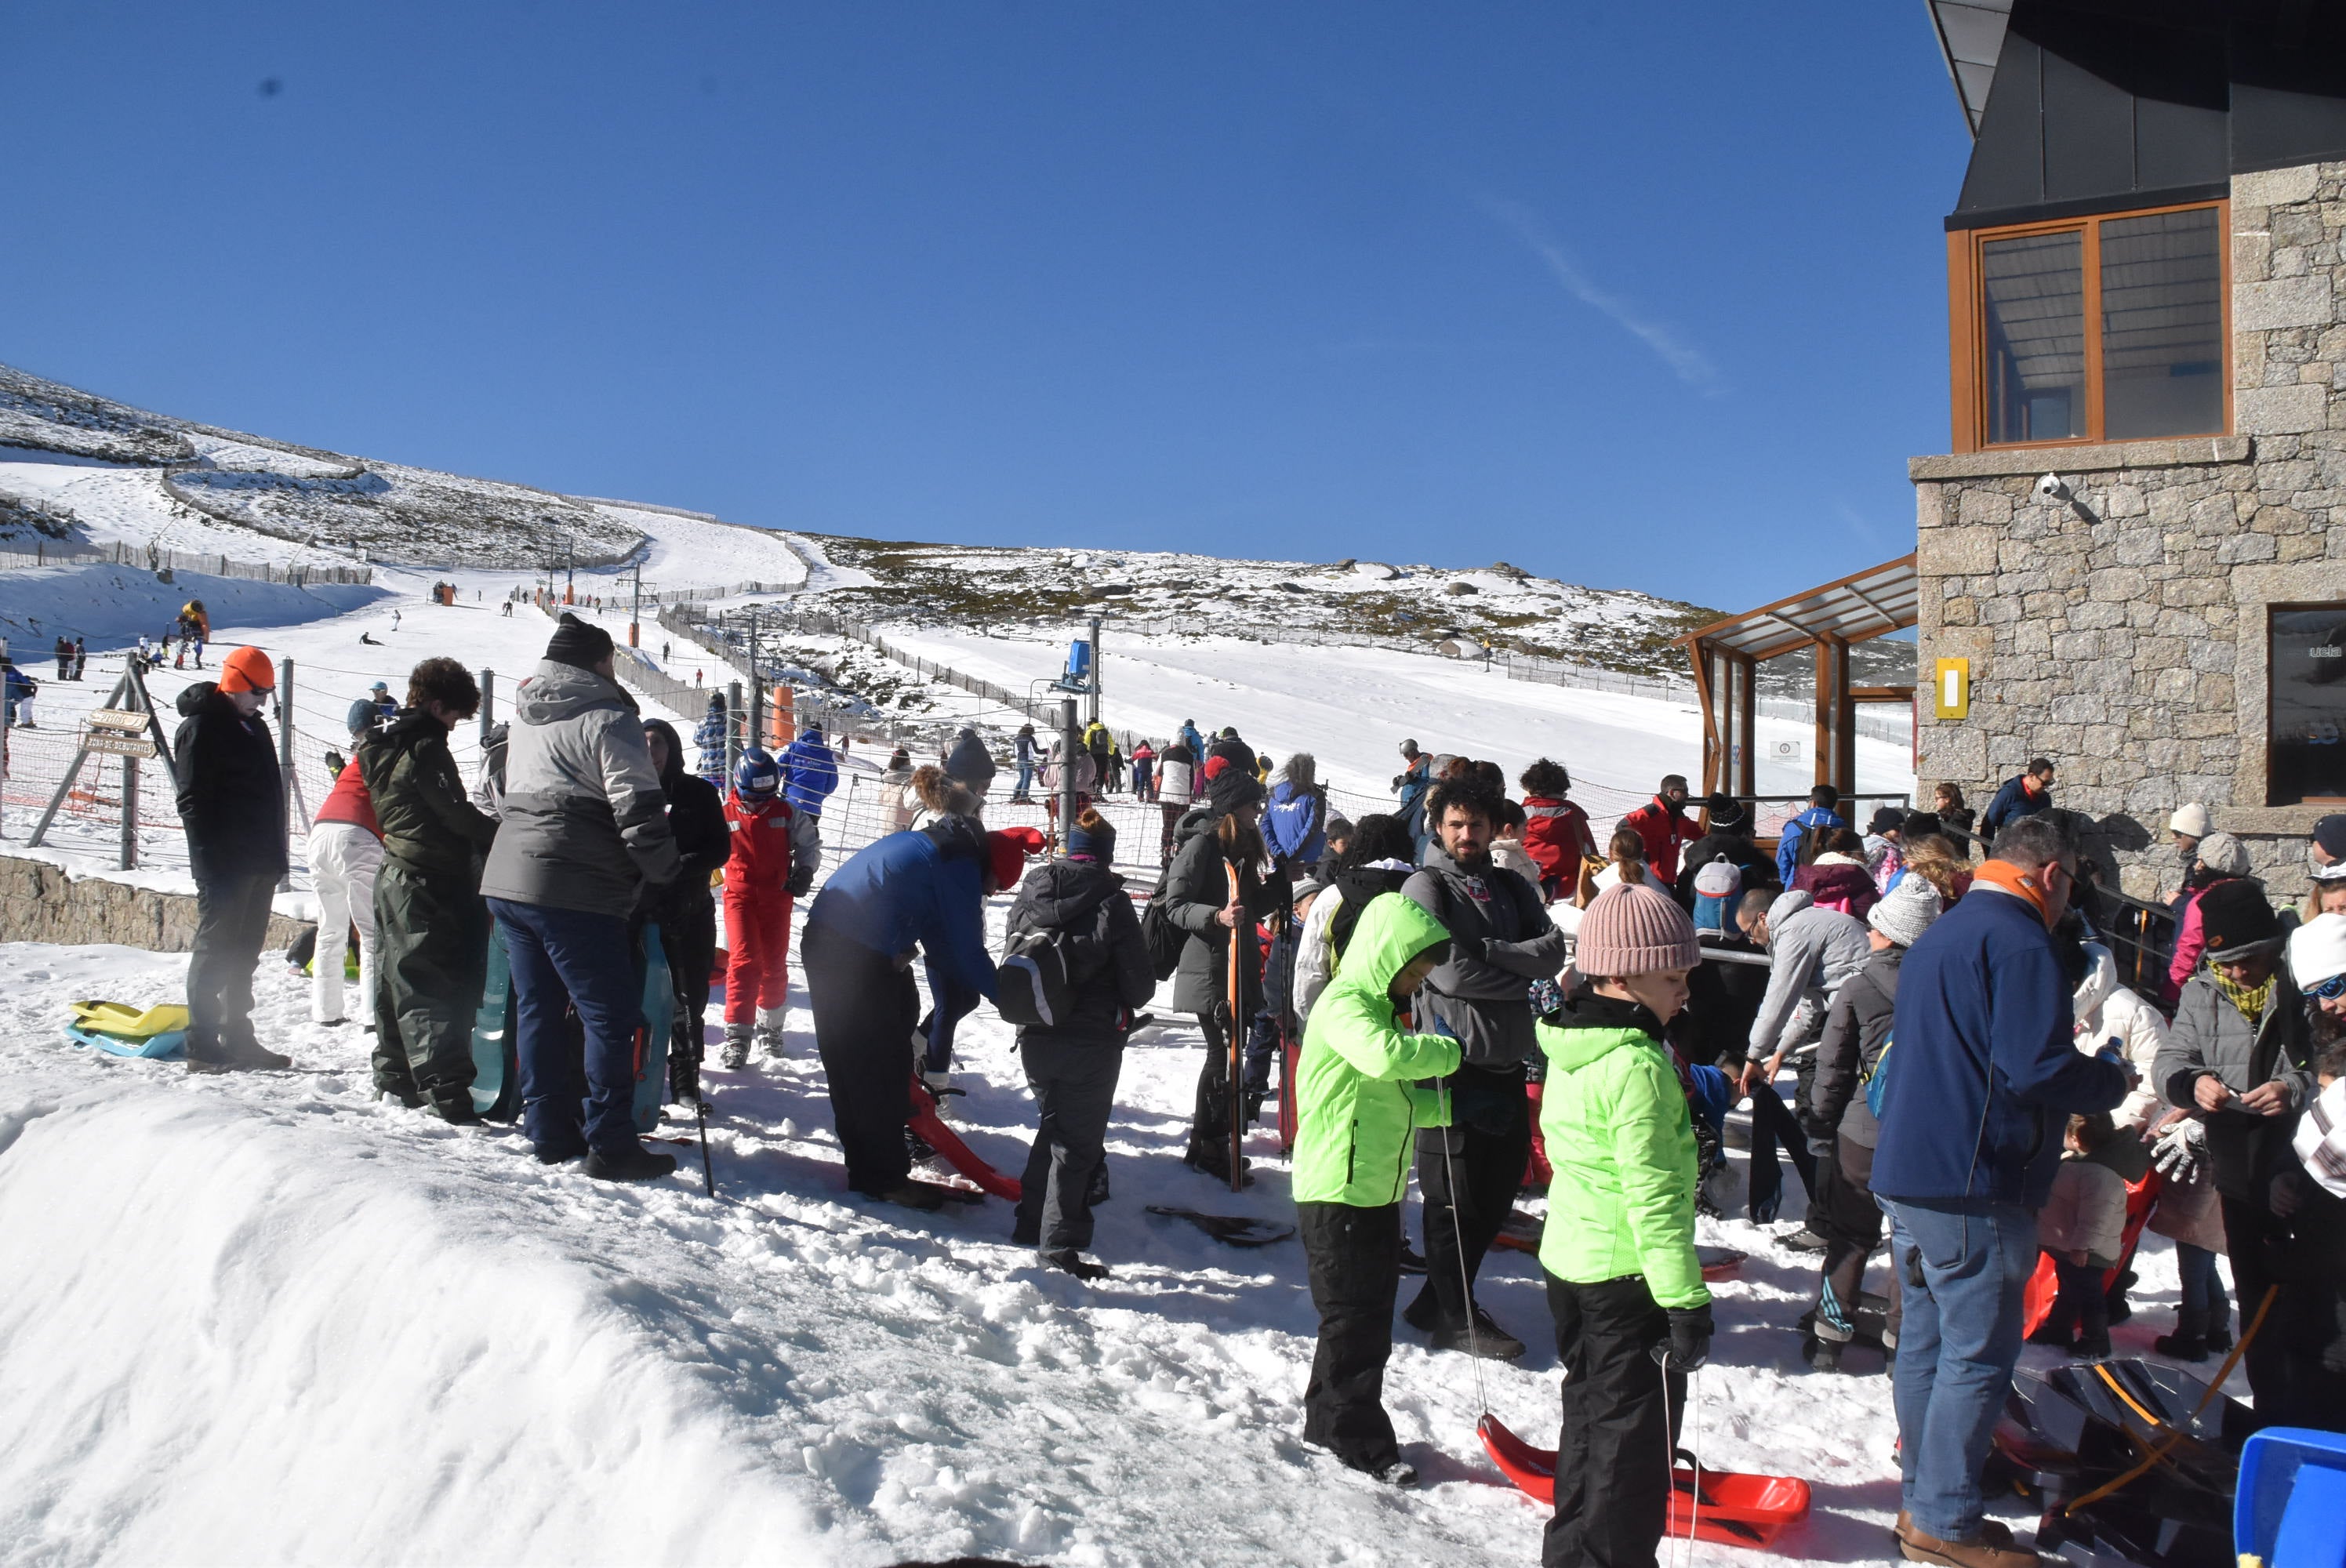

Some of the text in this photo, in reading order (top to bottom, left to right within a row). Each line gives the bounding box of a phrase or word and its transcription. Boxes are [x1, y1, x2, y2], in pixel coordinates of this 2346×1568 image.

[88, 738, 152, 753] ZONA DE DEBUTANTES
